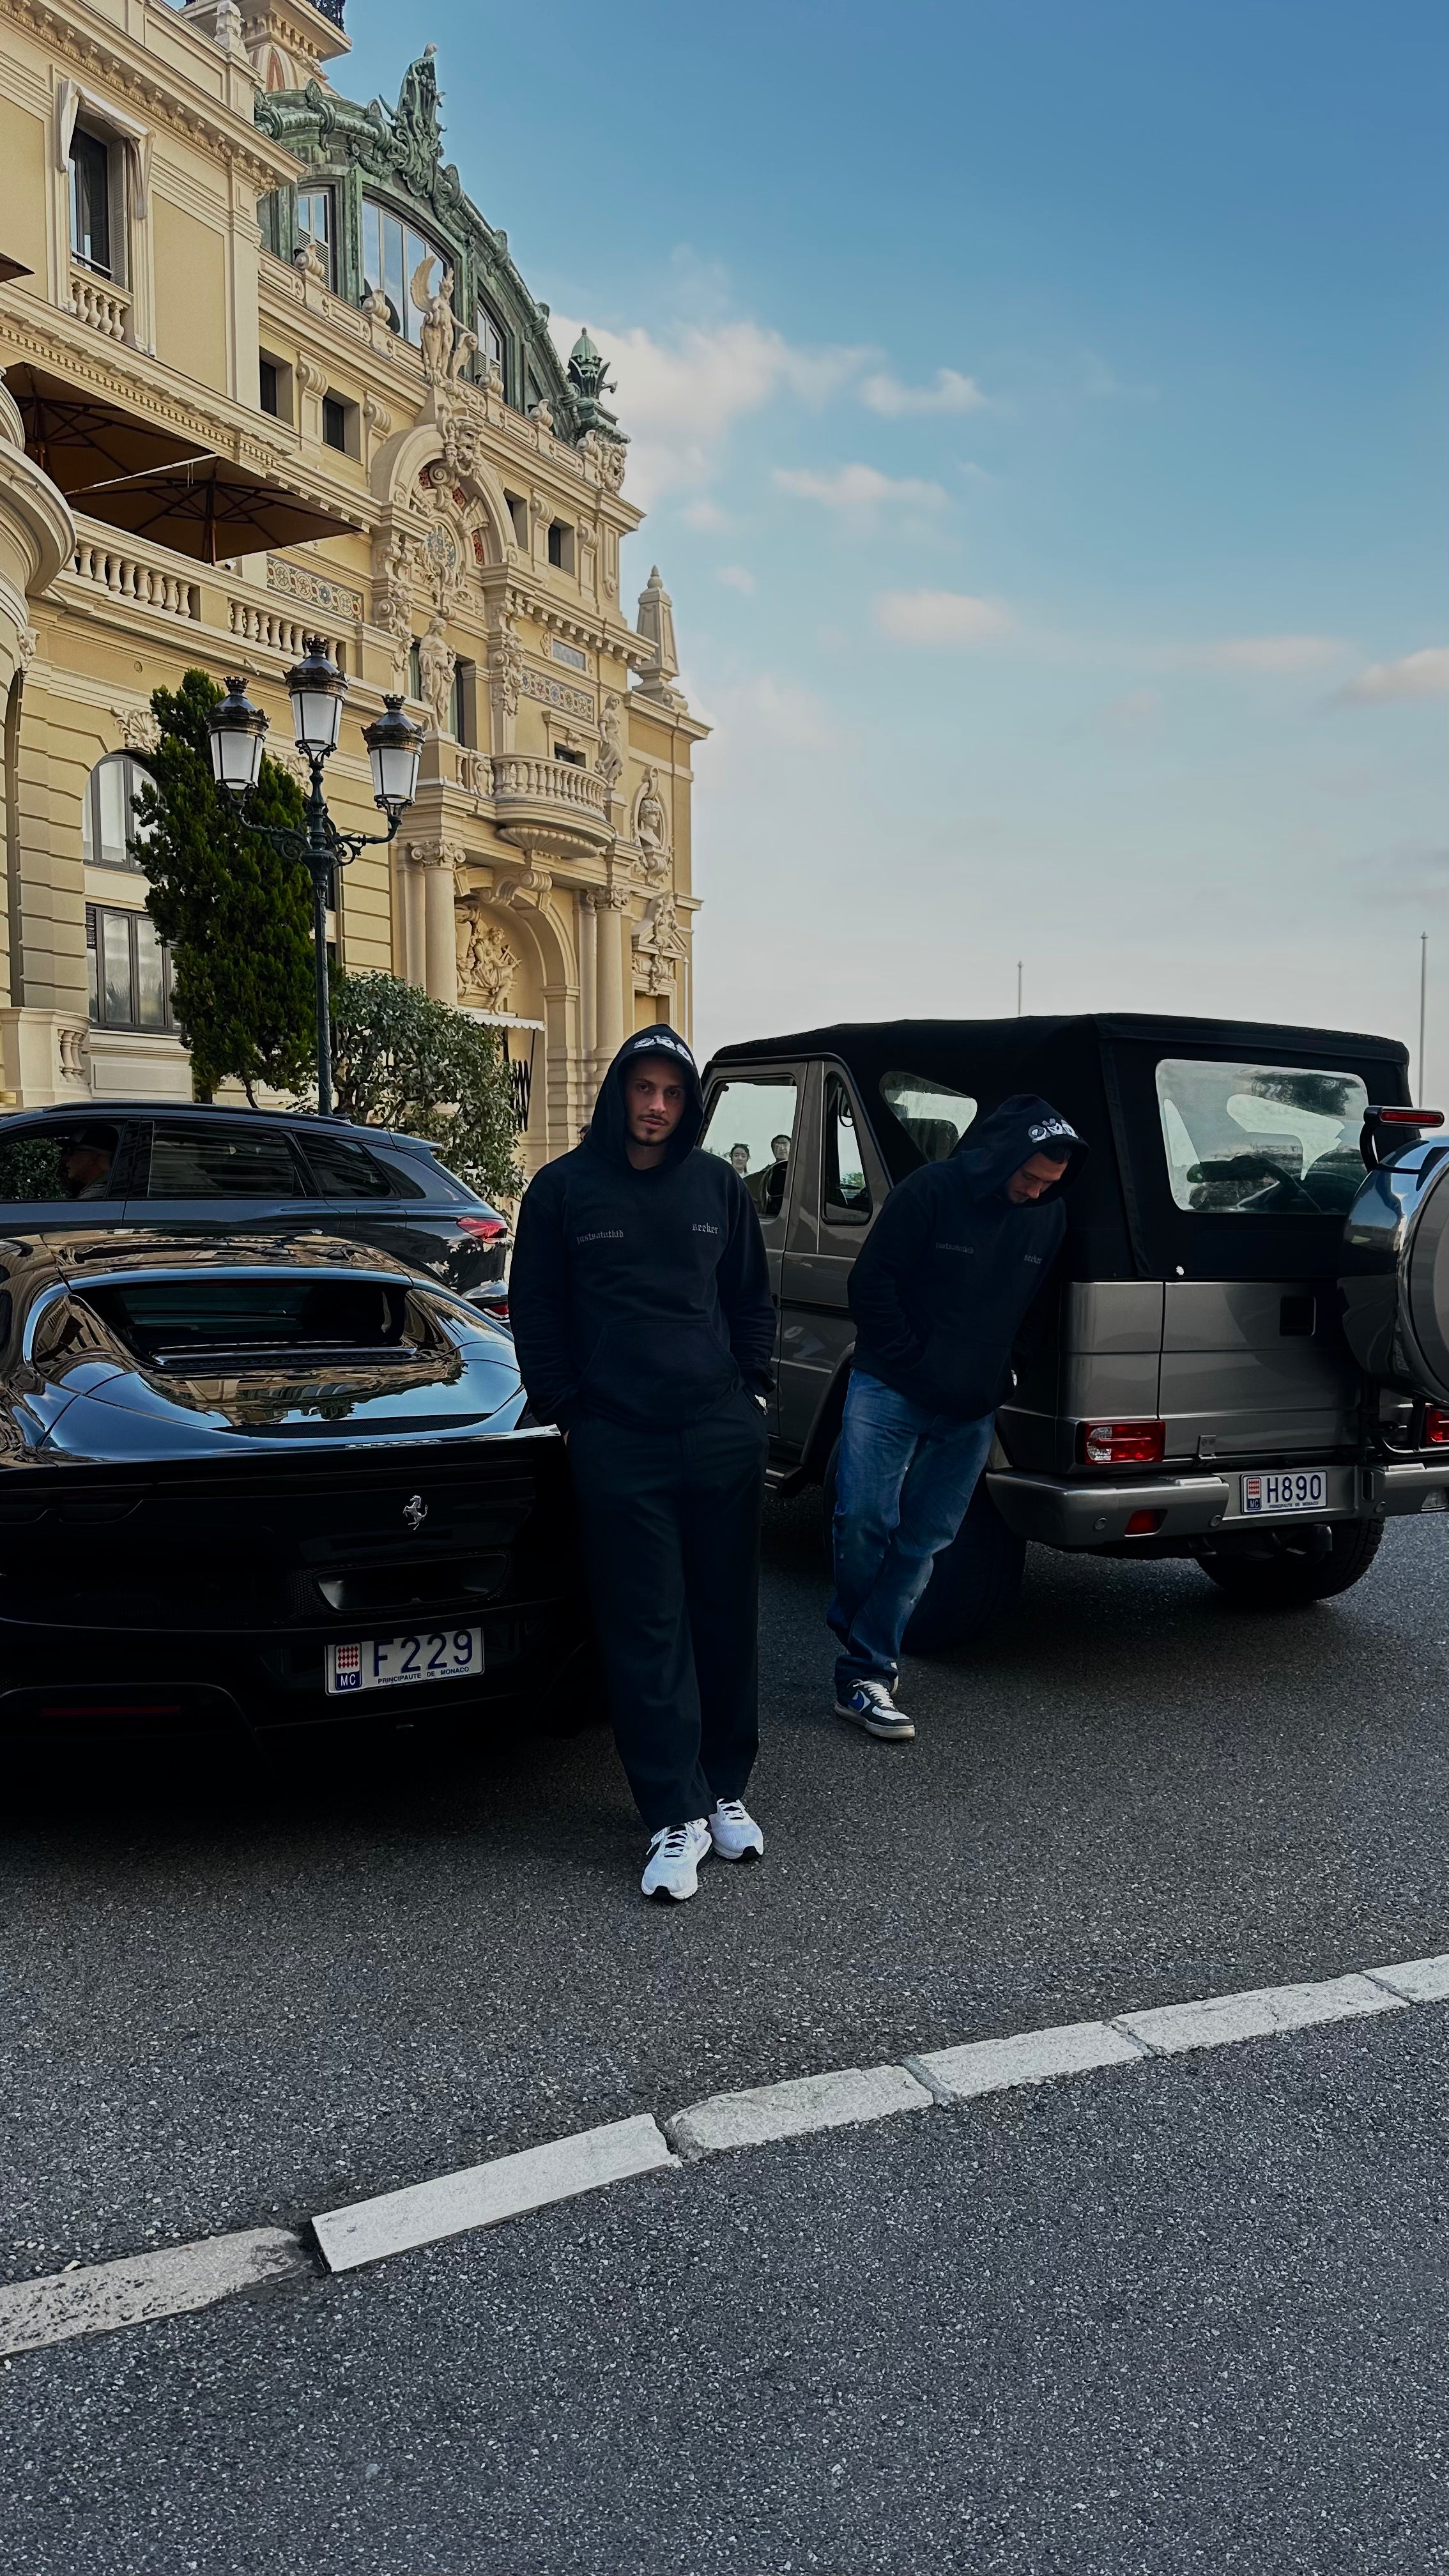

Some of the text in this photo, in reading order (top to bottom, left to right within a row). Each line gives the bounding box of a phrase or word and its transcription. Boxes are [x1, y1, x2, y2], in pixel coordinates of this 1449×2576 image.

[1267, 1475, 1321, 1503] H890
[1250, 1499, 1259, 1508] MC
[374, 1630, 473, 1676] F229
[341, 1673, 356, 1687] MC
[378, 1673, 422, 1684] PRINCIPAUTE
[440, 1666, 470, 1675] MONACO
